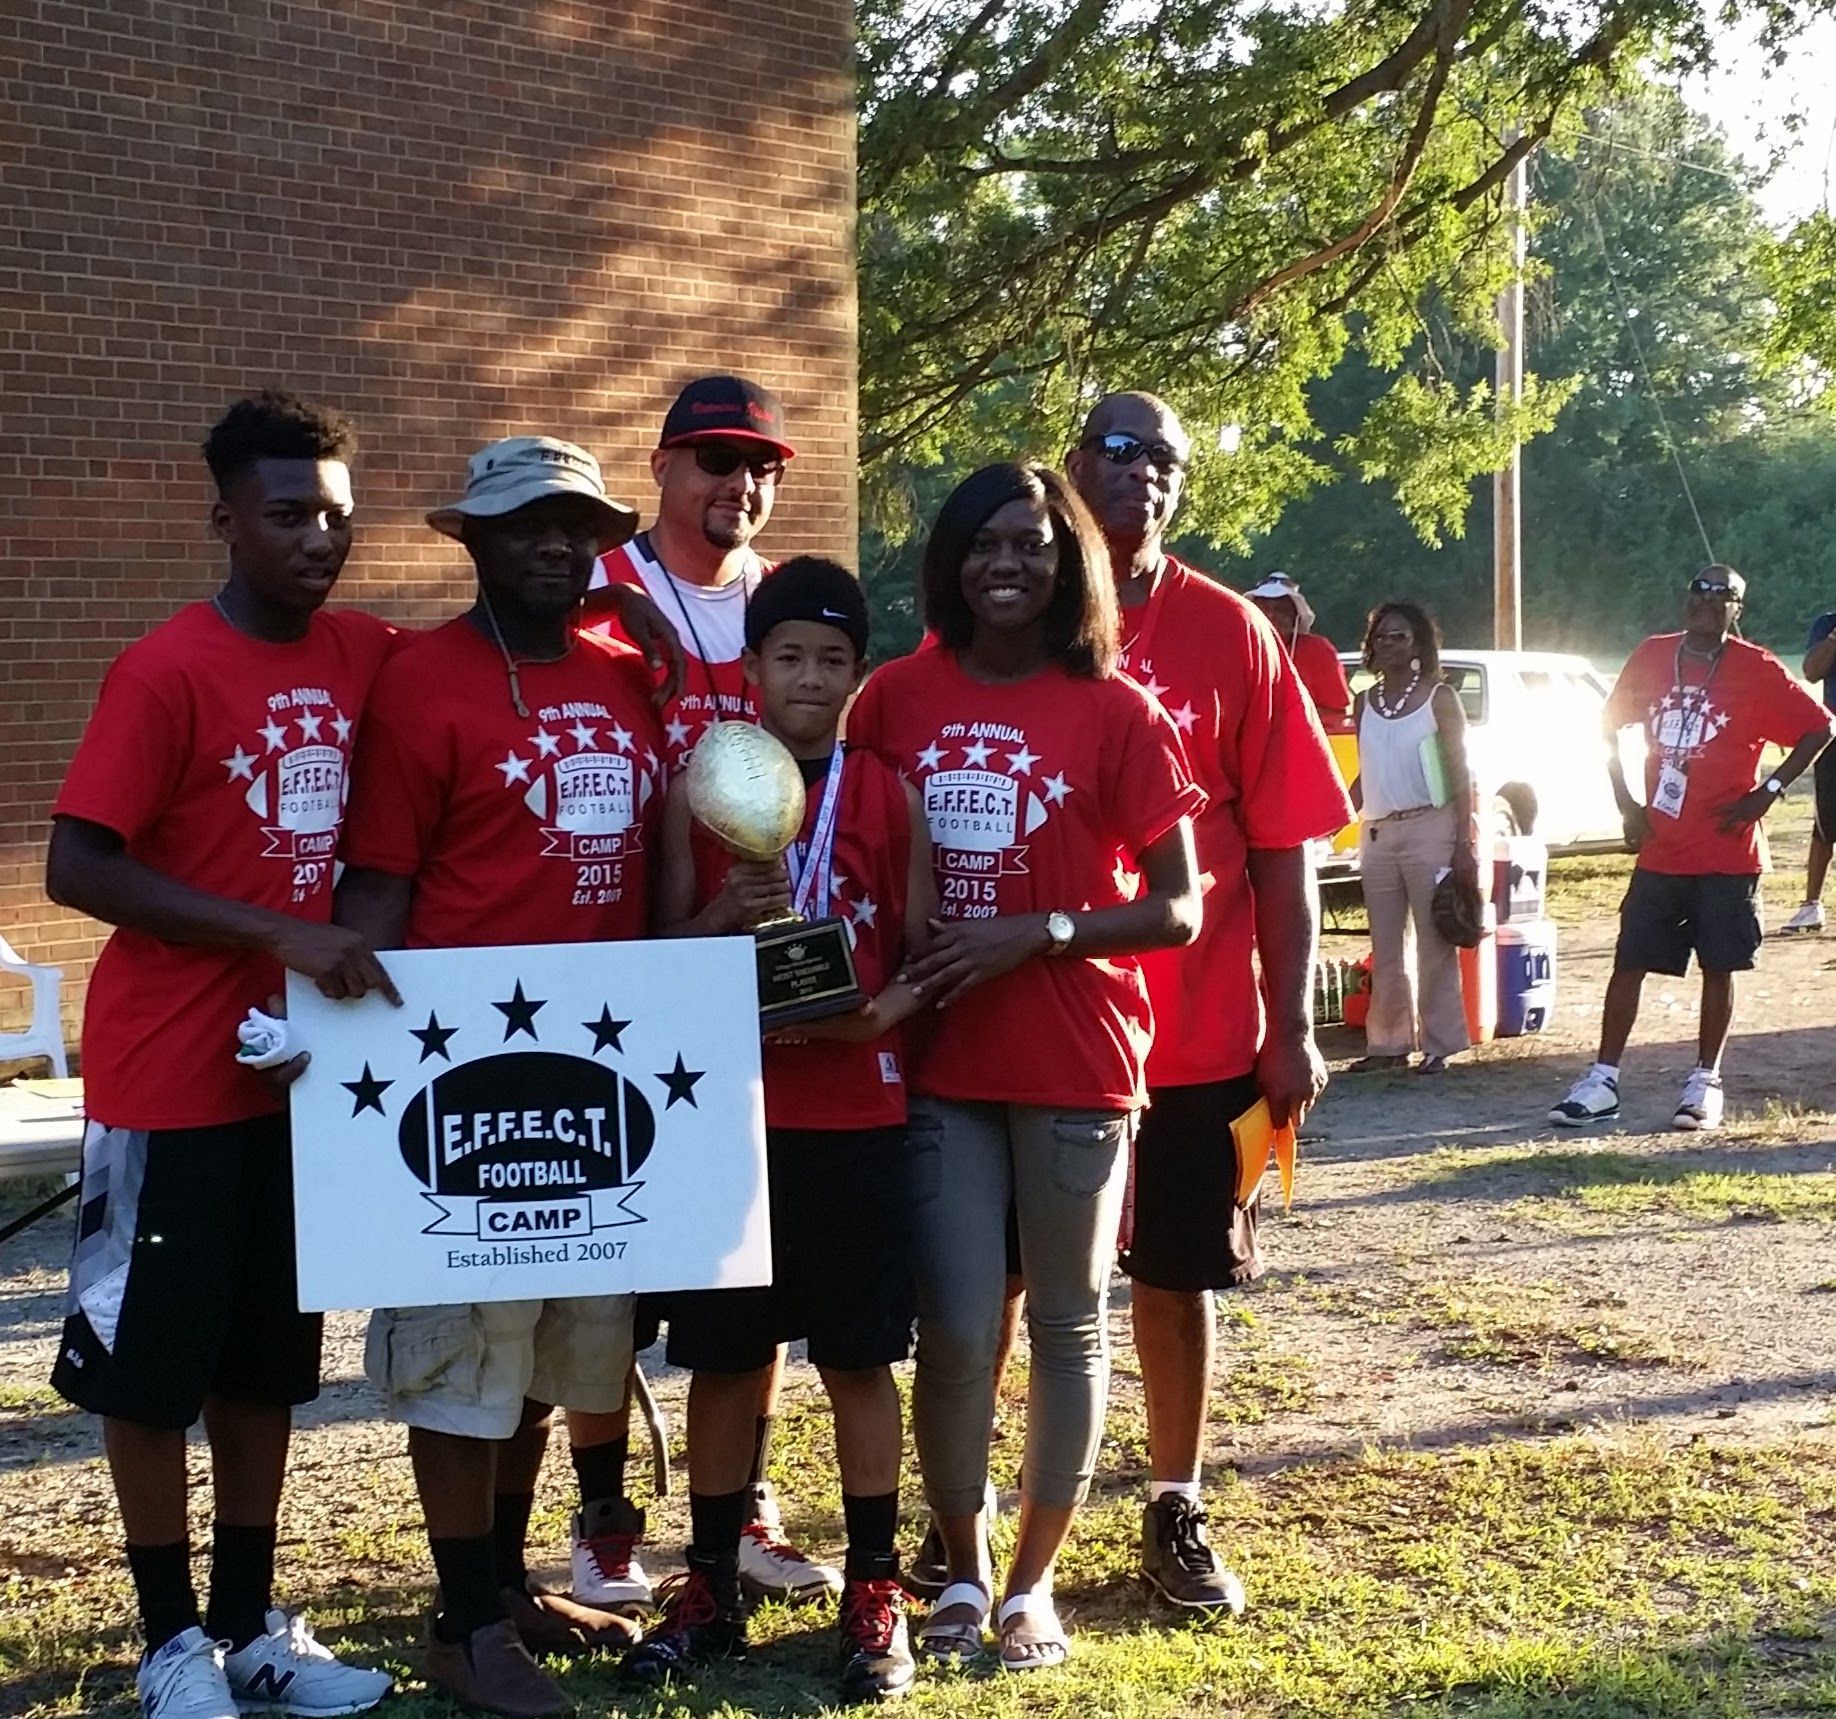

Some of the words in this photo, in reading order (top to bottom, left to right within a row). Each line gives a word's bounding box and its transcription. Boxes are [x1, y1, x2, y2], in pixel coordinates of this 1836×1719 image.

[267, 692, 291, 712] 9th
[538, 706, 562, 723] 9th
[562, 702, 612, 719] ANNUAL
[942, 723, 965, 739] 9th
[967, 722, 1026, 744] ANNUAL
[560, 773, 631, 799] E.F.F.E.C.T.
[559, 802, 631, 816] FOOTBALL
[927, 790, 1014, 816] E.F.F.E.C.T.
[928, 817, 1013, 833] FOOTBALL
[300, 835, 334, 854] CAMP
[579, 838, 621, 855] CAMP
[946, 853, 995, 871] CAMP
[577, 864, 622, 886] 2015
[944, 878, 996, 901] 2015
[963, 903, 998, 919] 2007
[443, 1107, 612, 1165] E.F.F.E.C.T.
[478, 1159, 587, 1188] FOOTBALL
[488, 1207, 582, 1232] CAMP
[446, 1243, 569, 1268] Established
[577, 1241, 628, 1261] 2007
